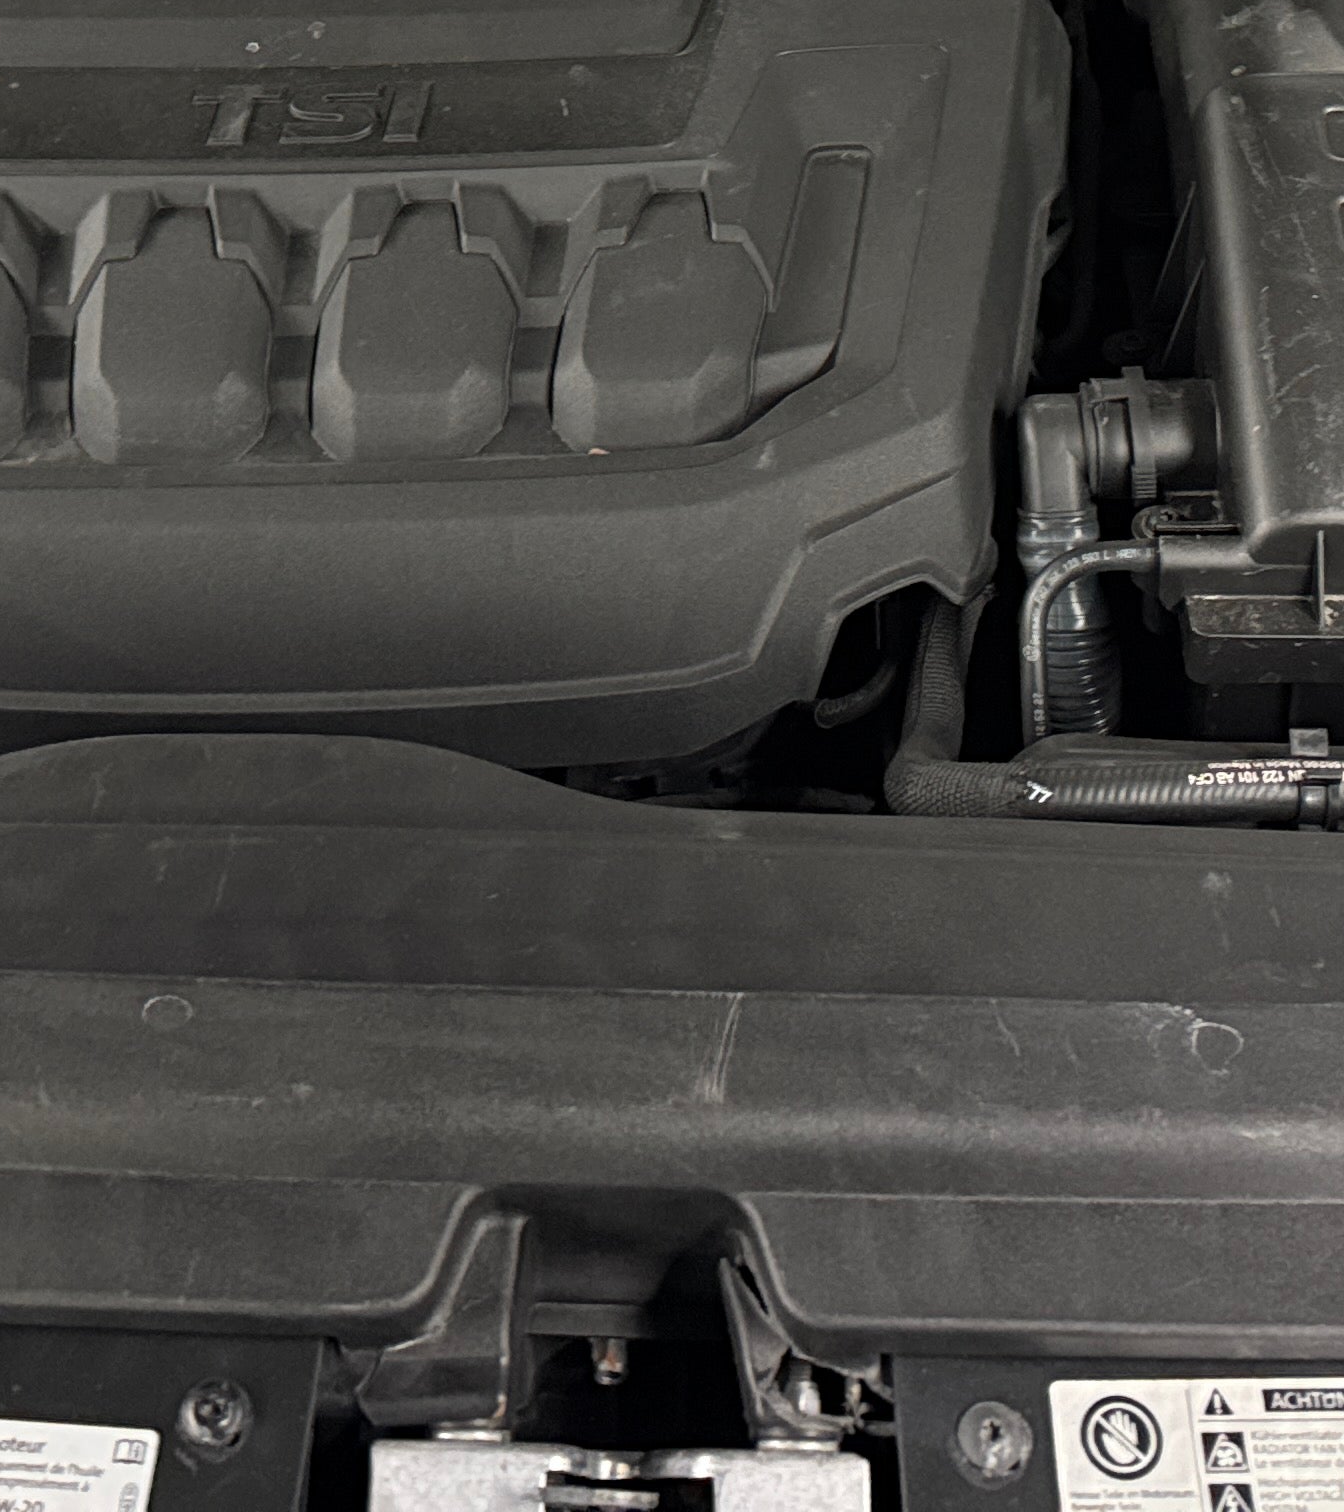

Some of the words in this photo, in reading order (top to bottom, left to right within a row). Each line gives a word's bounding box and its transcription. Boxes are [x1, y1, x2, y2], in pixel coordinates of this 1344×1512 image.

[193, 80, 434, 146] TSI
[1238, 771, 1259, 784] 101
[1261, 770, 1285, 783] 122
